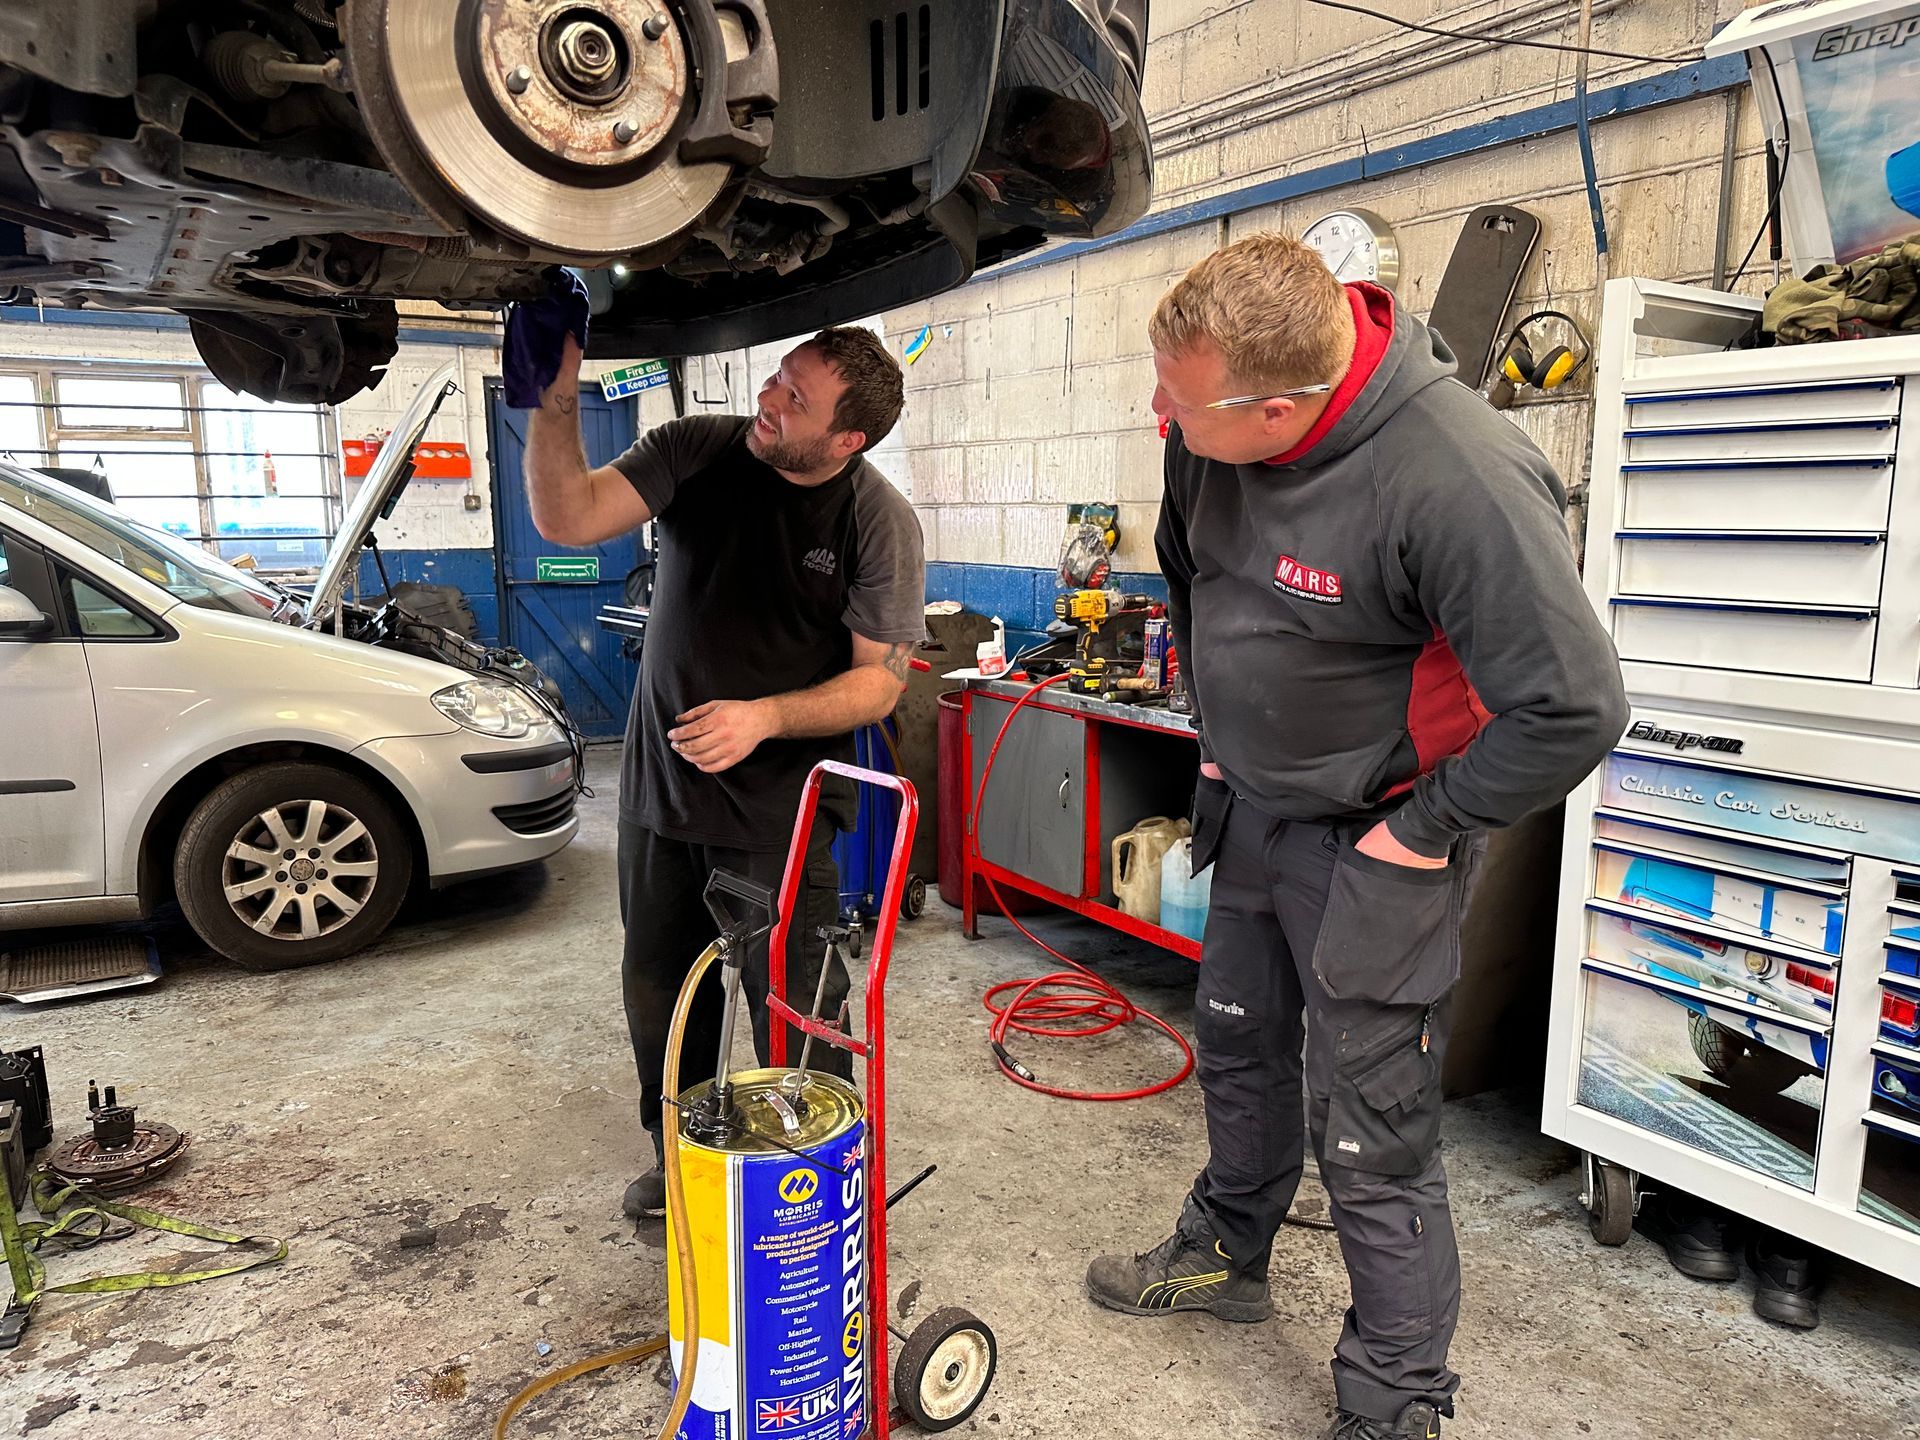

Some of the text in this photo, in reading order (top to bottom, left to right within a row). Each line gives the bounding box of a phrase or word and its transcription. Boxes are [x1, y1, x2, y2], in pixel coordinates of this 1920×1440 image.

[1331, 226, 1340, 236] 12
[1314, 235, 1321, 246] 11
[1365, 242, 1371, 252] 2
[1368, 265, 1375, 276] 3
[625, 361, 663, 378] Fire exit
[626, 373, 669, 391] Keep clear
[804, 548, 836, 569] MAC
[802, 559, 833, 575] TOOLS
[1277, 559, 1338, 594] MARS
[1626, 720, 1745, 755] Snap-on
[1620, 775, 1868, 833] Classic Car Series
[773, 1199, 823, 1218] MORRIS
[779, 1210, 819, 1222] LUBRICANTS
[753, 1225, 839, 1251] lubricants and associated
[759, 1220, 835, 1243] A range of world-class
[766, 1237, 830, 1259] products designed
[788, 1251, 819, 1264] perform.
[779, 1265, 819, 1279] Agriculture
[779, 1277, 819, 1291] Automotive
[765, 1284, 831, 1305] Commercial Vehicle
[781, 1301, 819, 1315] Motorcycle
[793, 1316, 808, 1325] Rail
[788, 1327, 813, 1338] Marine
[778, 1335, 821, 1351] Off-Highway
[783, 1348, 817, 1362] Industrial
[770, 1355, 829, 1376] Power Generation
[779, 1371, 821, 1387] Horticulture
[802, 1383, 836, 1402] MADE IN THE
[802, 1389, 837, 1421] UK
